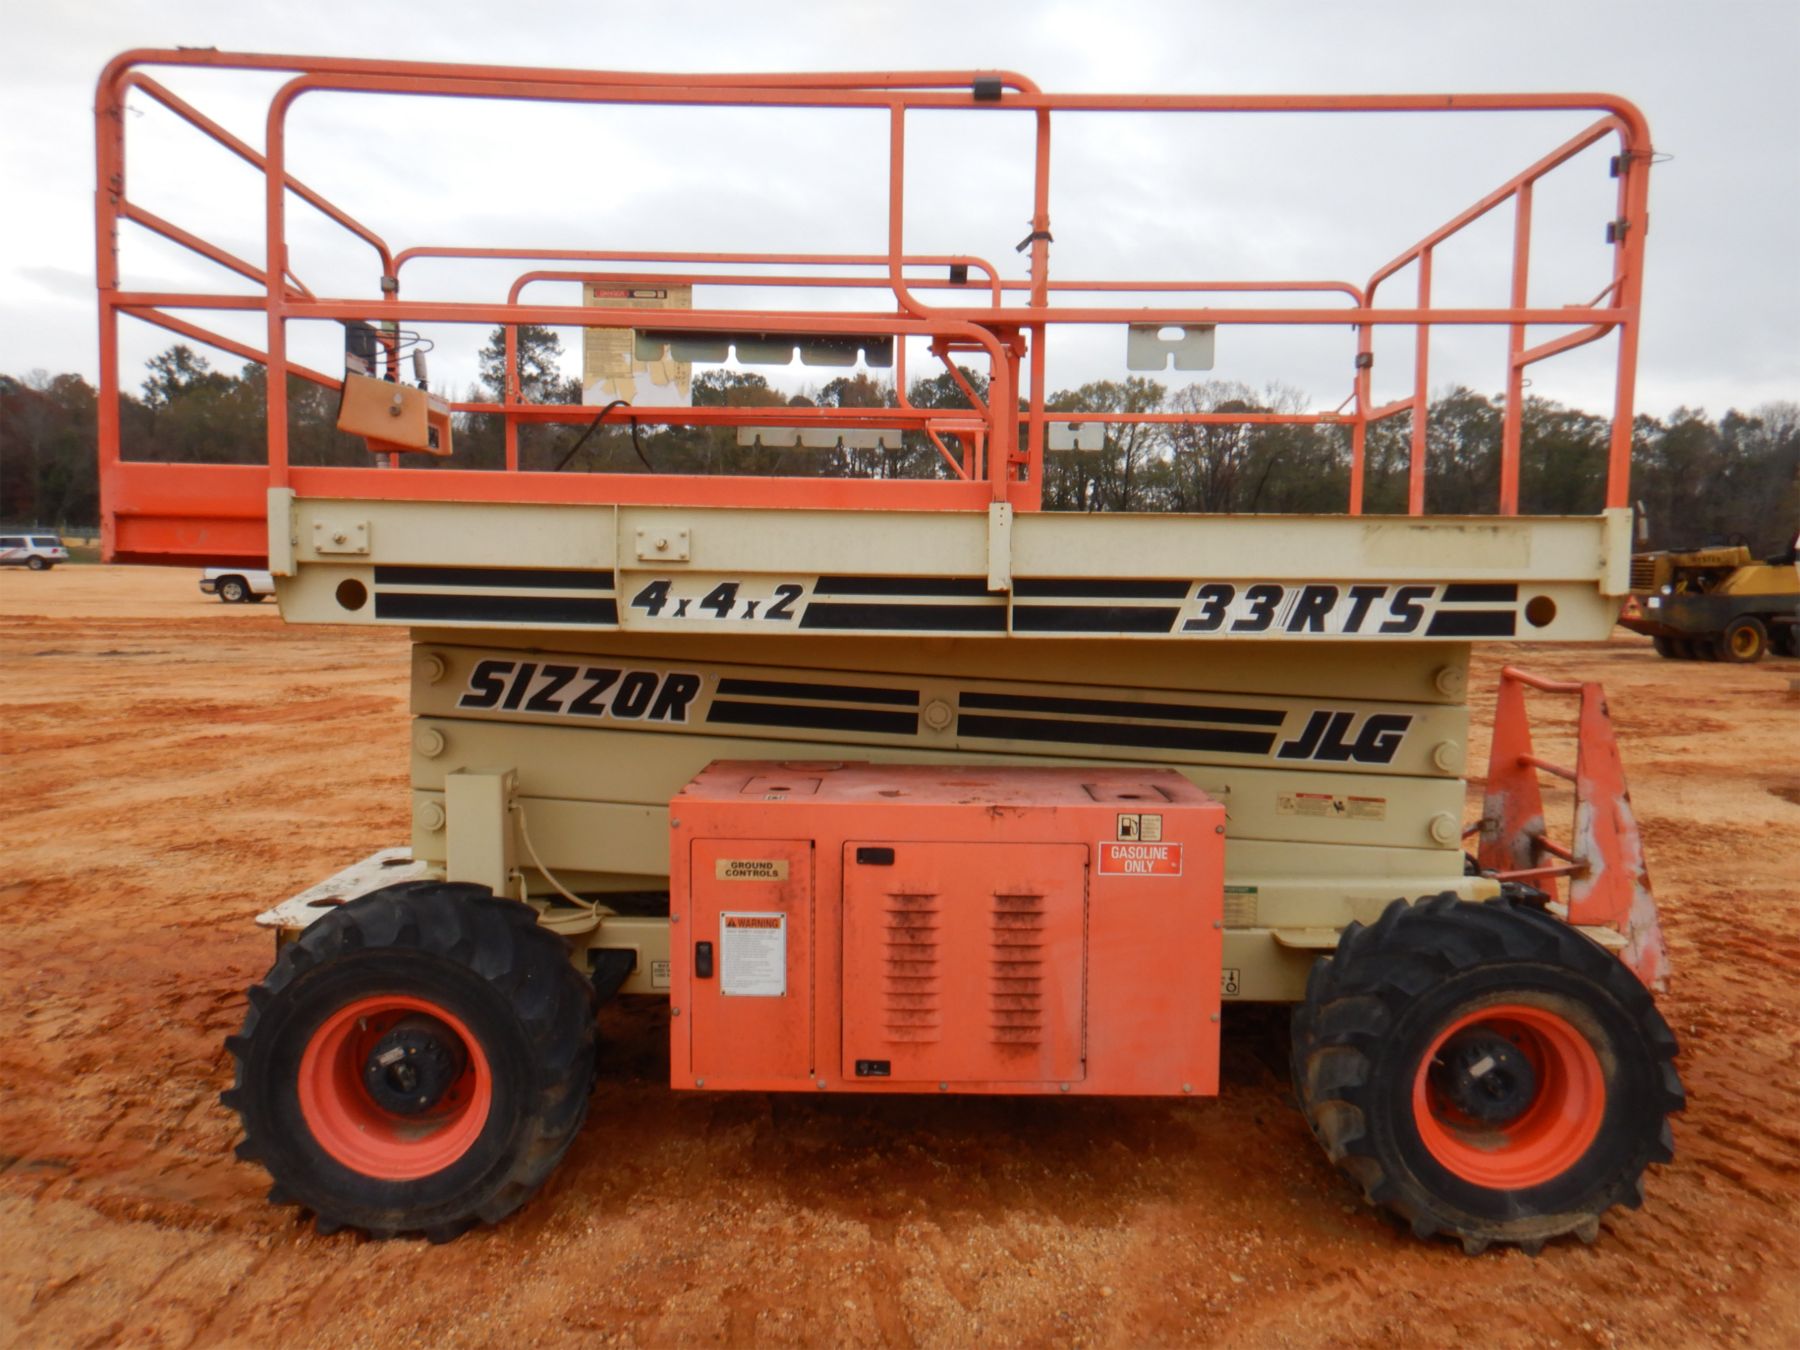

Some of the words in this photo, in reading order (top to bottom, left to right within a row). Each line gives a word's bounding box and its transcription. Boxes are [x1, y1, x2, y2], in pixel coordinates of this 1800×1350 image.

[459, 660, 701, 722] SIZZOR
[1276, 710, 1414, 764] JLG
[1111, 846, 1168, 860] GASOLINE
[730, 861, 773, 869] GROUND
[1124, 860, 1154, 873] ONLY
[725, 869, 779, 878] CONTROLS
[737, 918, 779, 928] WARNING
